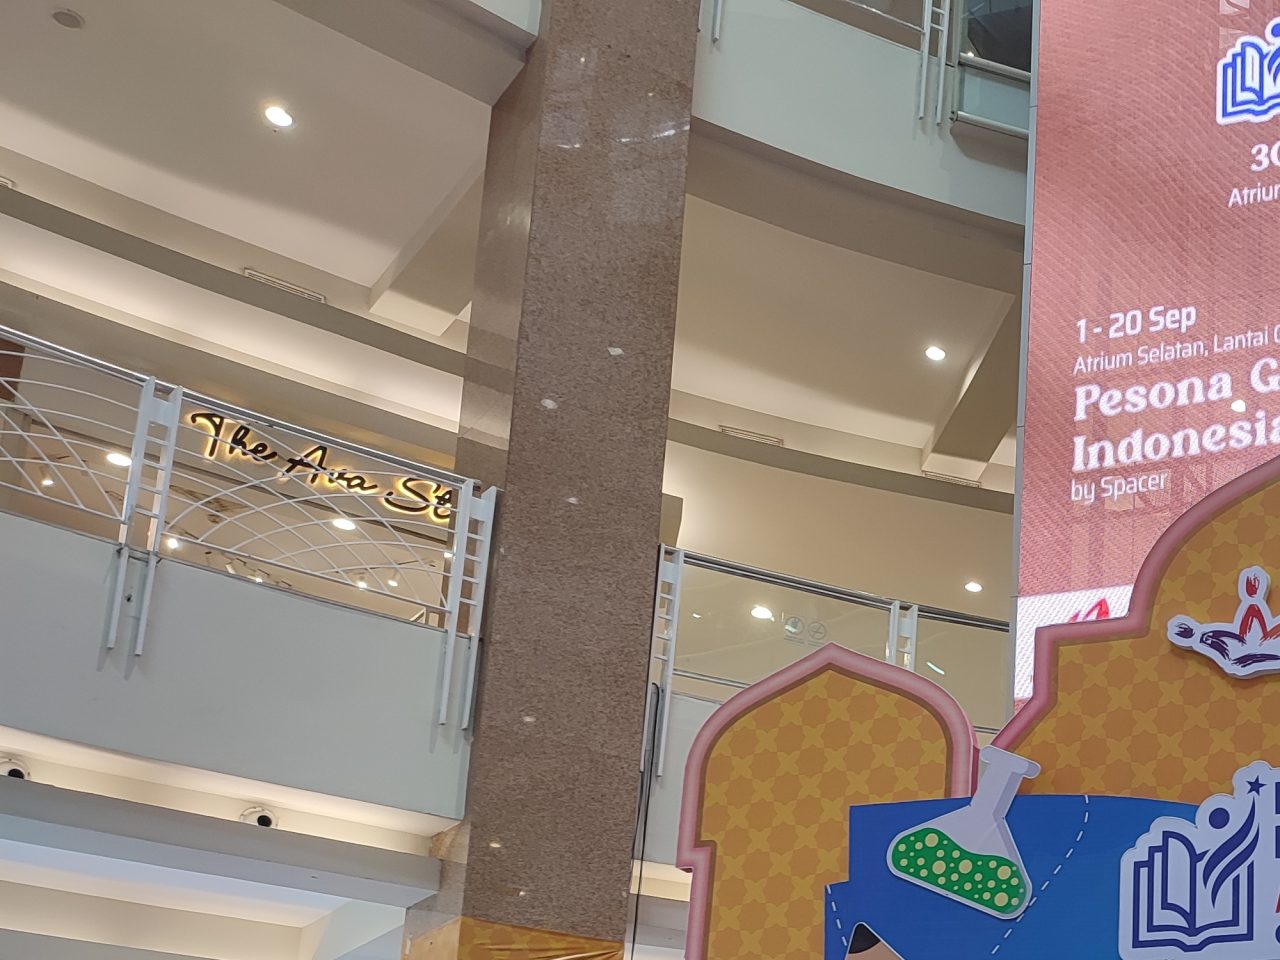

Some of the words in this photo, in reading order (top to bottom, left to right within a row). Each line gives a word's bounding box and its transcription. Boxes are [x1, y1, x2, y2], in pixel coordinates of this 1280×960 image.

[1076, 318, 1087, 344] 1
[1108, 309, 1143, 339] 20
[1148, 305, 1197, 333] Sep
[1073, 353, 1132, 377] Atrium
[1137, 338, 1209, 366] Selatan,
[1213, 326, 1269, 354] Lantai
[1073, 371, 1233, 422] Pesona
[191, 412, 278, 463] The
[281, 445, 377, 491] Ava
[1070, 477, 1095, 504] by
[1100, 470, 1169, 499] Spacer
